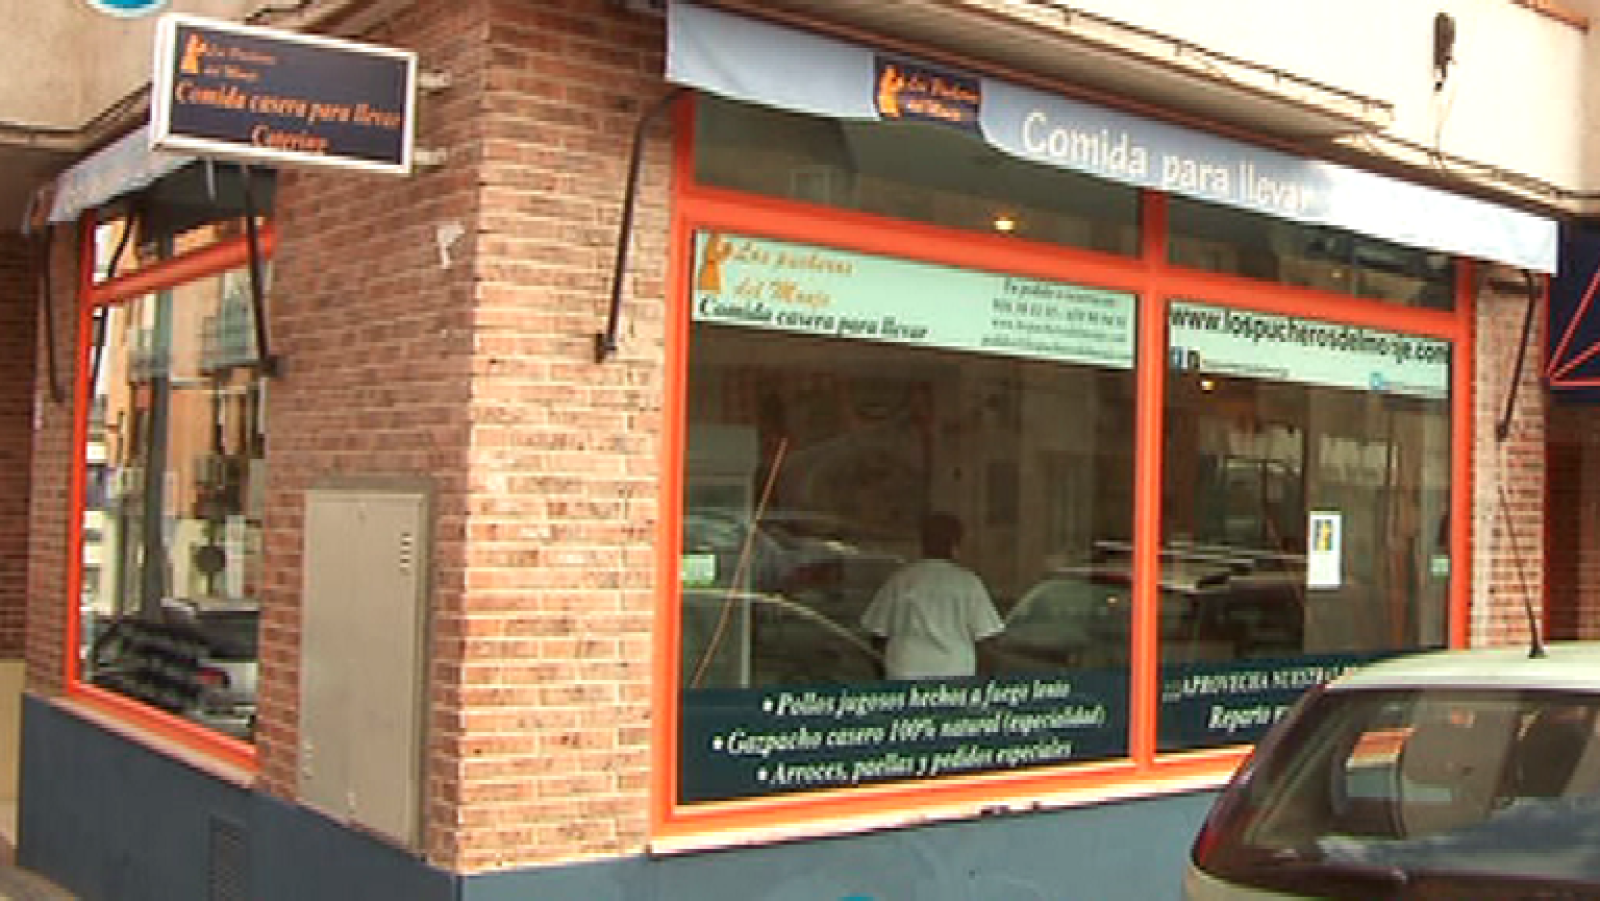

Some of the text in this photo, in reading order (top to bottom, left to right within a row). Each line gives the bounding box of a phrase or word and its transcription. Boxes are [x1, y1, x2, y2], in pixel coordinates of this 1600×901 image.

[175, 80, 401, 128] Comida casera para llevar
[1023, 112, 1308, 211] Comida para llevar
[699, 296, 929, 340] Comida casera para llevar
[777, 678, 1072, 719] Pollos jugosos hechos a fuego lento
[1208, 704, 1273, 733] Reparto
[728, 726, 823, 758] Gazpacho
[826, 727, 886, 747] casero
[889, 716, 938, 742] 100%
[940, 707, 1001, 738] natural
[771, 736, 1073, 788] Arroces, paellas y pedidos especiales
